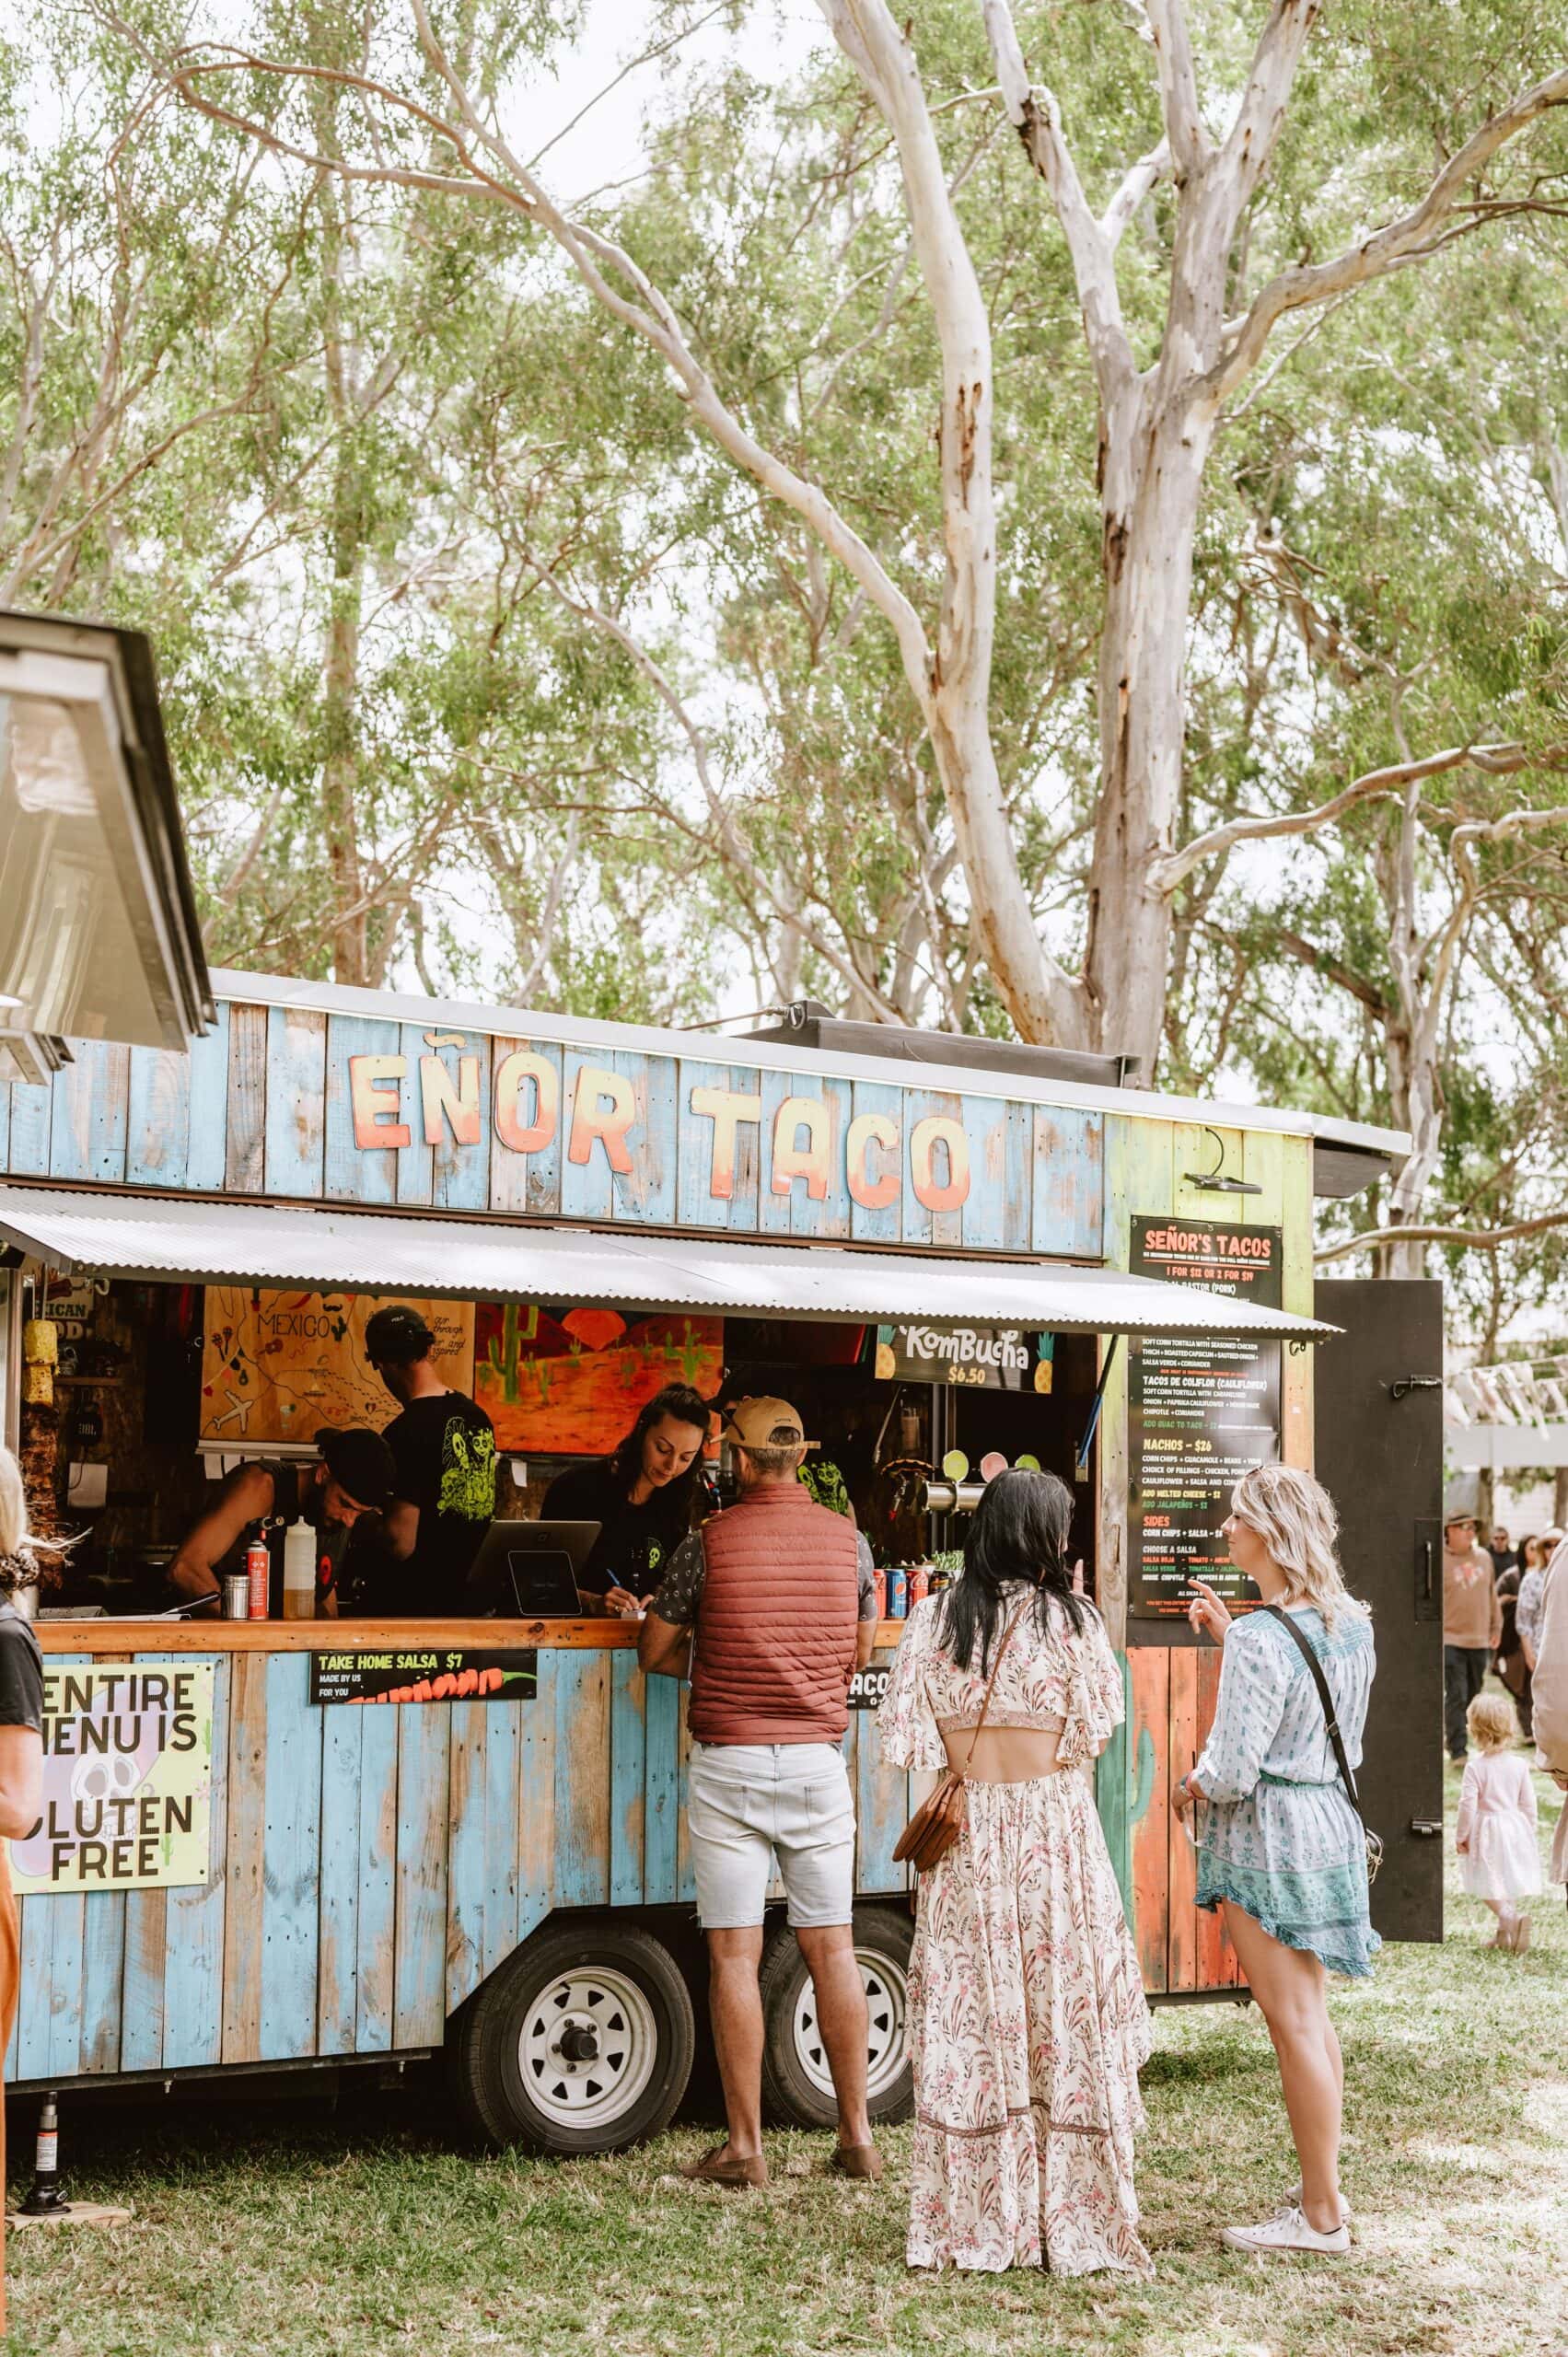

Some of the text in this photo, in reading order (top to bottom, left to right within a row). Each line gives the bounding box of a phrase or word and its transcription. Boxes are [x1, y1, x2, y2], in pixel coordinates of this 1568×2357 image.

[350, 1032, 970, 1213] EÑOR TACO
[1144, 1225, 1272, 1258] SEÑOR'S TACOS
[1173, 1267, 1188, 1276] FOR
[1204, 1269, 1215, 1278] OR
[1225, 1271, 1239, 1281] FOR
[258, 1313, 331, 1339] MEXICO
[948, 1364, 986, 1384] $6.50
[1143, 1376, 1168, 1386] TACOS
[1170, 1377, 1180, 1387] DE
[1144, 1438, 1183, 1451] NACHOS
[1195, 1440, 1212, 1453] $26
[1144, 1515, 1170, 1527] SIDES
[1143, 1529, 1161, 1538] CORN
[1162, 1529, 1180, 1538] CHIPS
[1188, 1529, 1208, 1538] SALSA
[1177, 1546, 1197, 1554] SALSA
[319, 1653, 463, 1671] TAKE HOME SALSA $7
[319, 1674, 361, 1683] MADE BY US
[42, 1674, 194, 1713] ENTIRE
[319, 1689, 349, 1697] FOR YOU
[158, 1713, 197, 1752] IS
[22, 1795, 192, 1840] LUTEN
[52, 1838, 159, 1881] FREE
